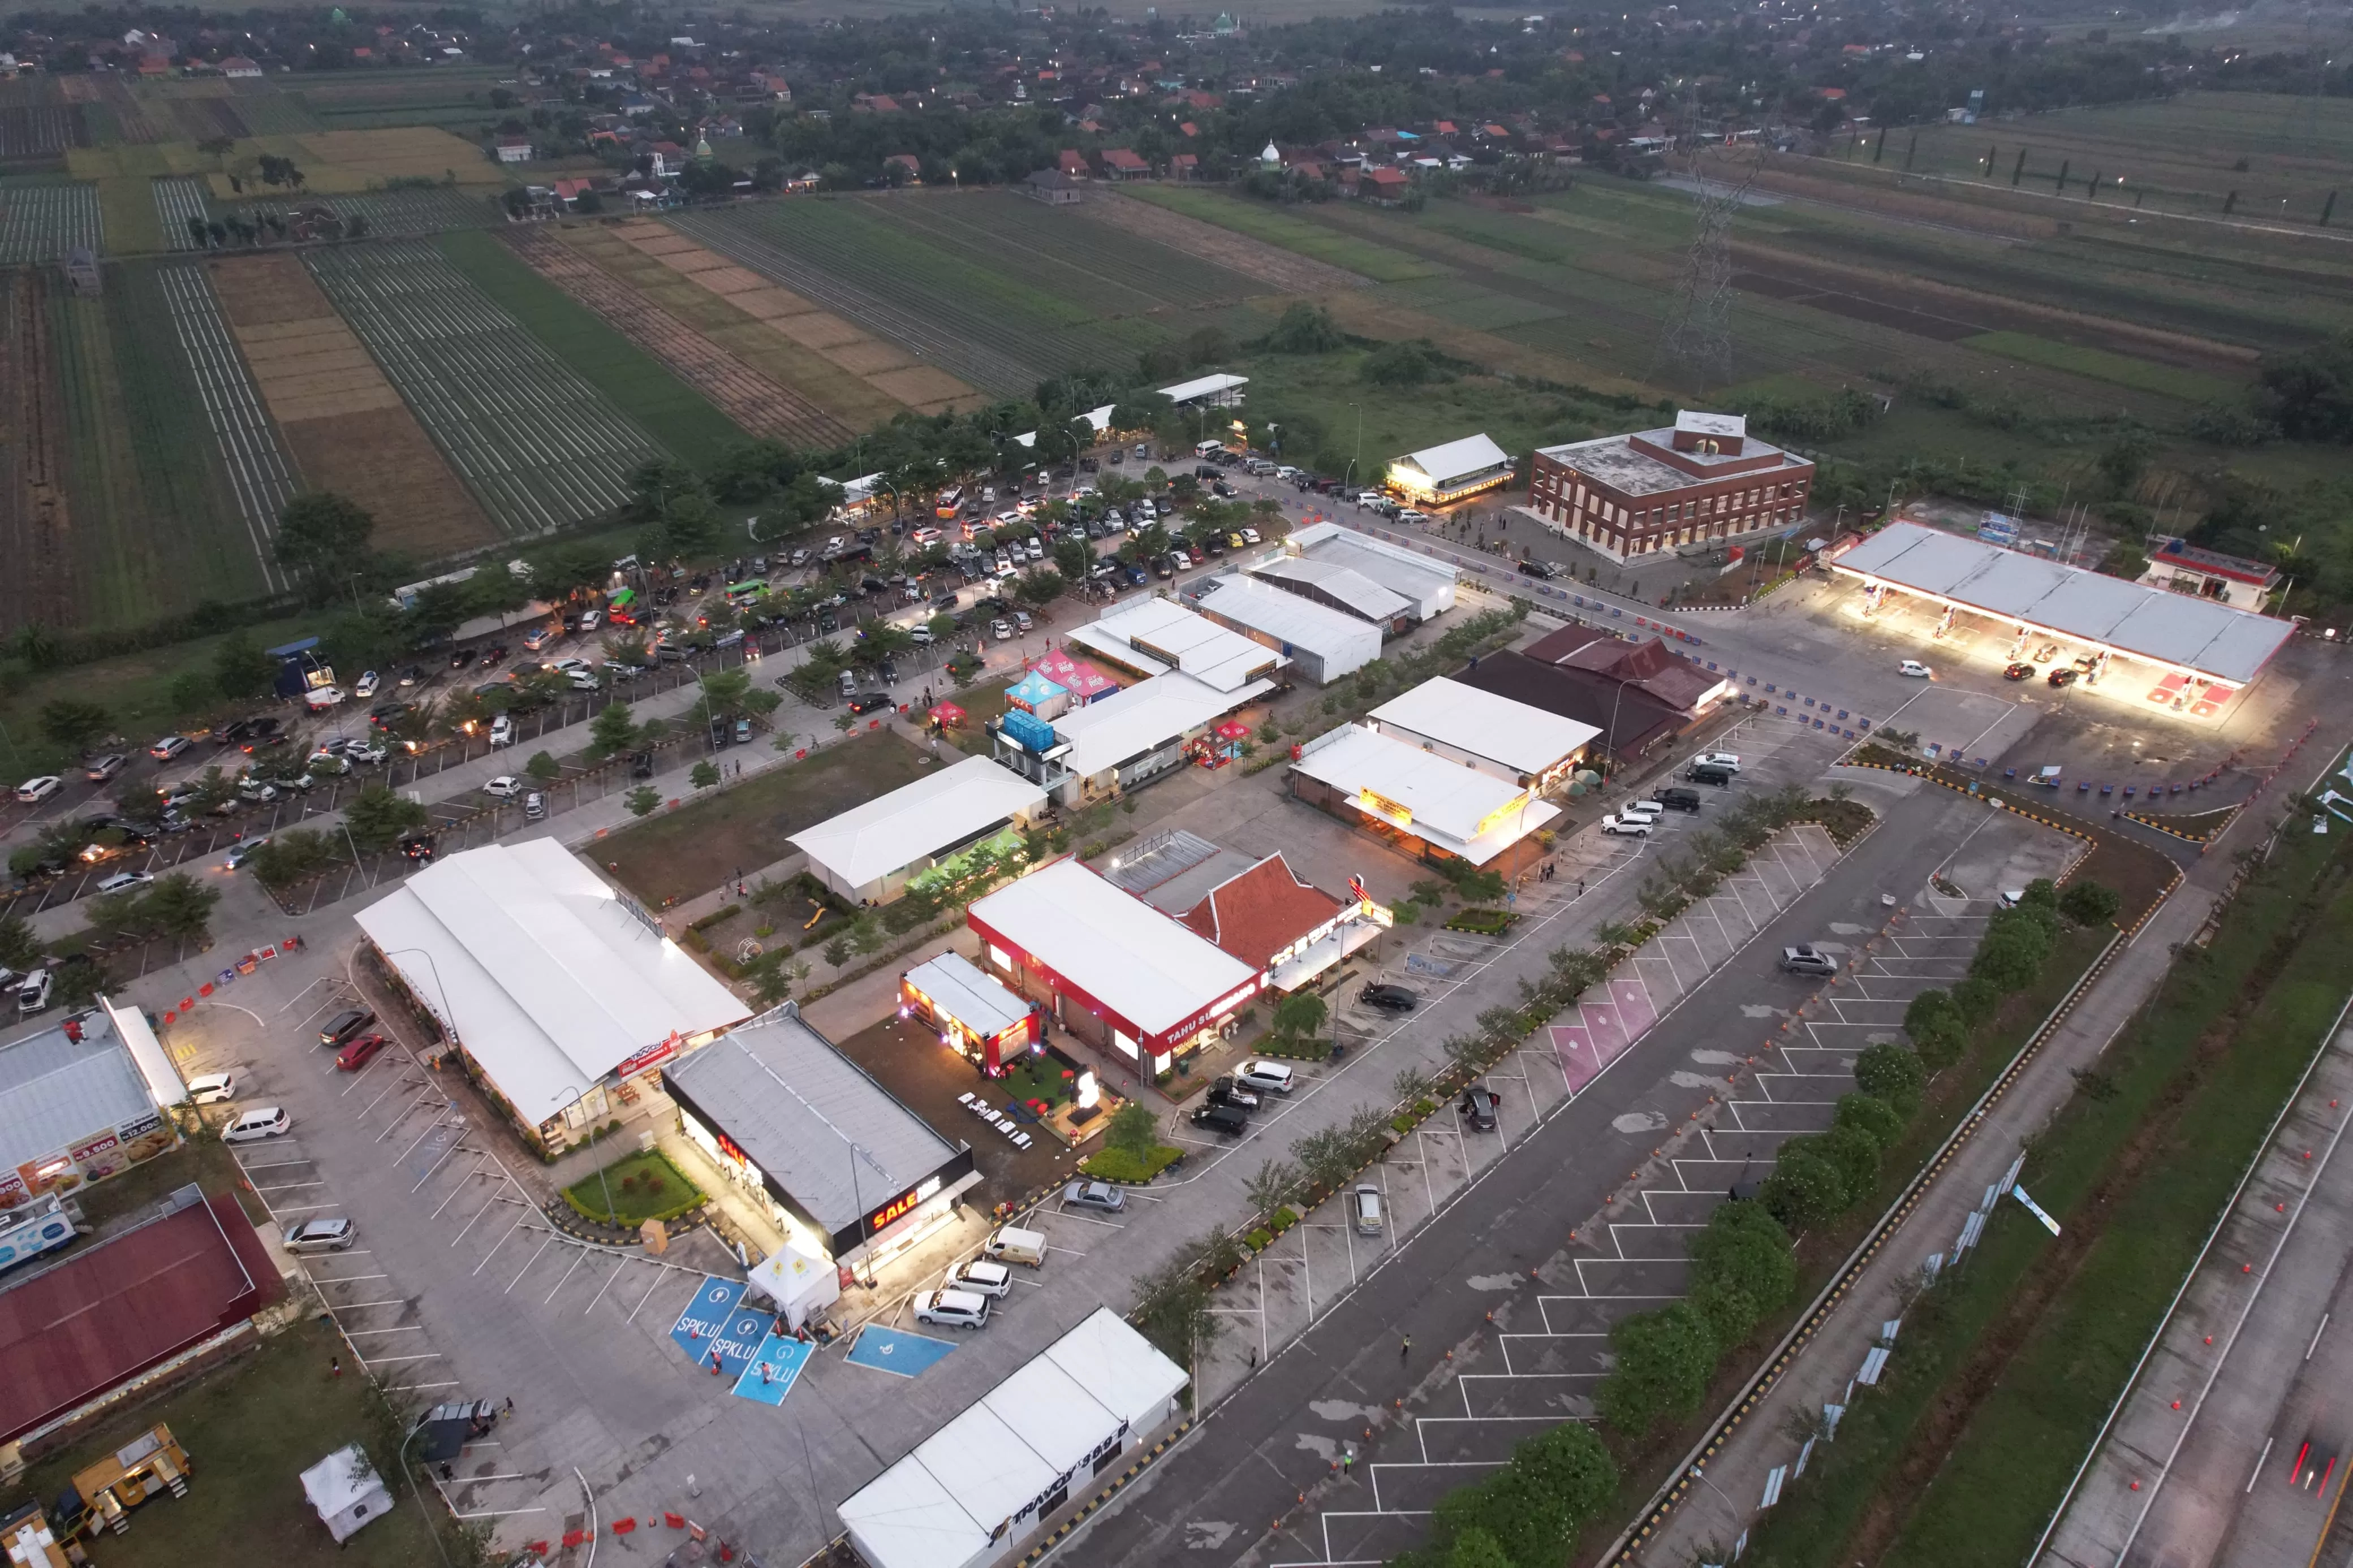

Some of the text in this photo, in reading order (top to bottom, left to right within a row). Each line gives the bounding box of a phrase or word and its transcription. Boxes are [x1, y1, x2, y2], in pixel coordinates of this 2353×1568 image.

[1167, 1020, 1196, 1044] TAHU
[631, 1042, 661, 1060] TRAVOY
[873, 1190, 917, 1229] SALE
[678, 1316, 721, 1338] SPKLU
[712, 1338, 757, 1360] SPKLU
[750, 1360, 794, 1383] SKLU
[1012, 1463, 1078, 1524] TRAVOY
[1081, 1436, 1113, 1468] 389
